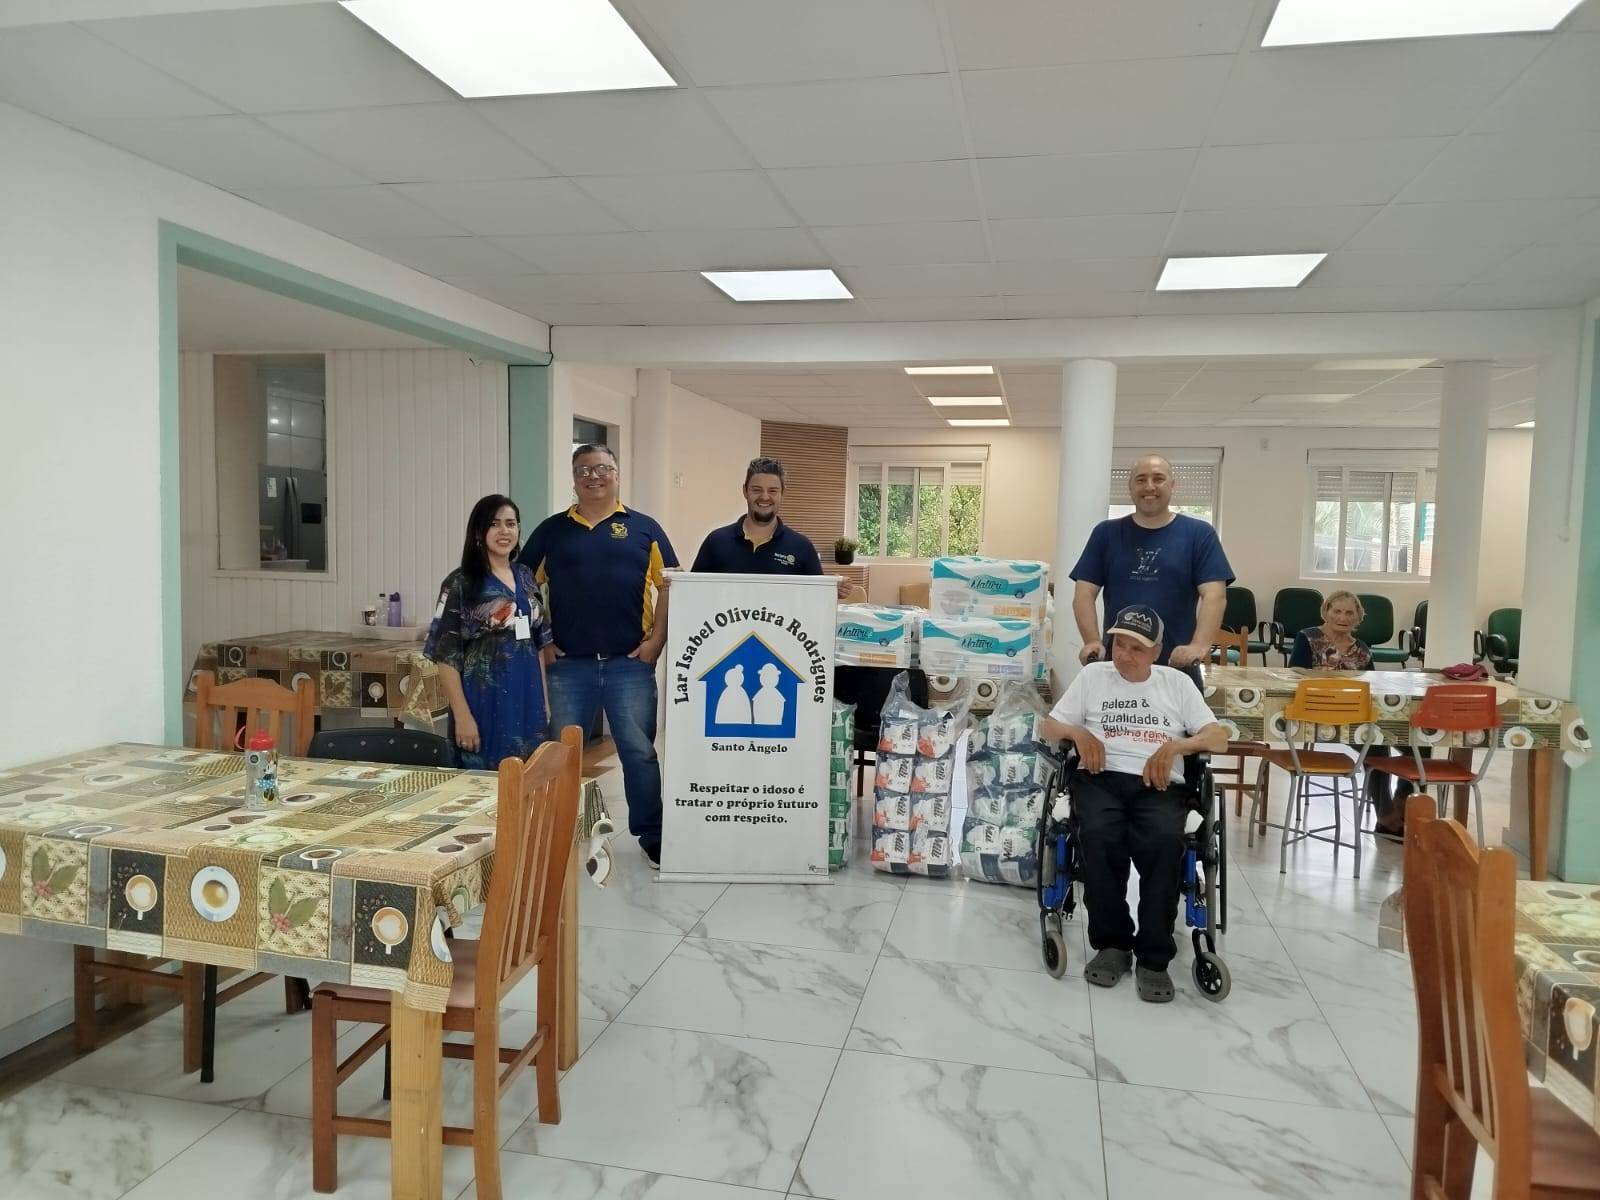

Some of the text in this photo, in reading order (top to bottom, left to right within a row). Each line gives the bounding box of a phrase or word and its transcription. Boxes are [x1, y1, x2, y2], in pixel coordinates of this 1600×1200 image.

[674, 606, 827, 705] Lar Isabel Oliveira Rodrigues
[1100, 712, 1160, 725] Qualidade
[711, 740, 788, 755] Santo Ângelo
[689, 782, 805, 795] Respeitar o idoso é
[675, 798, 819, 810] tratar o próprio futuro
[705, 813, 788, 825] com respeito.
